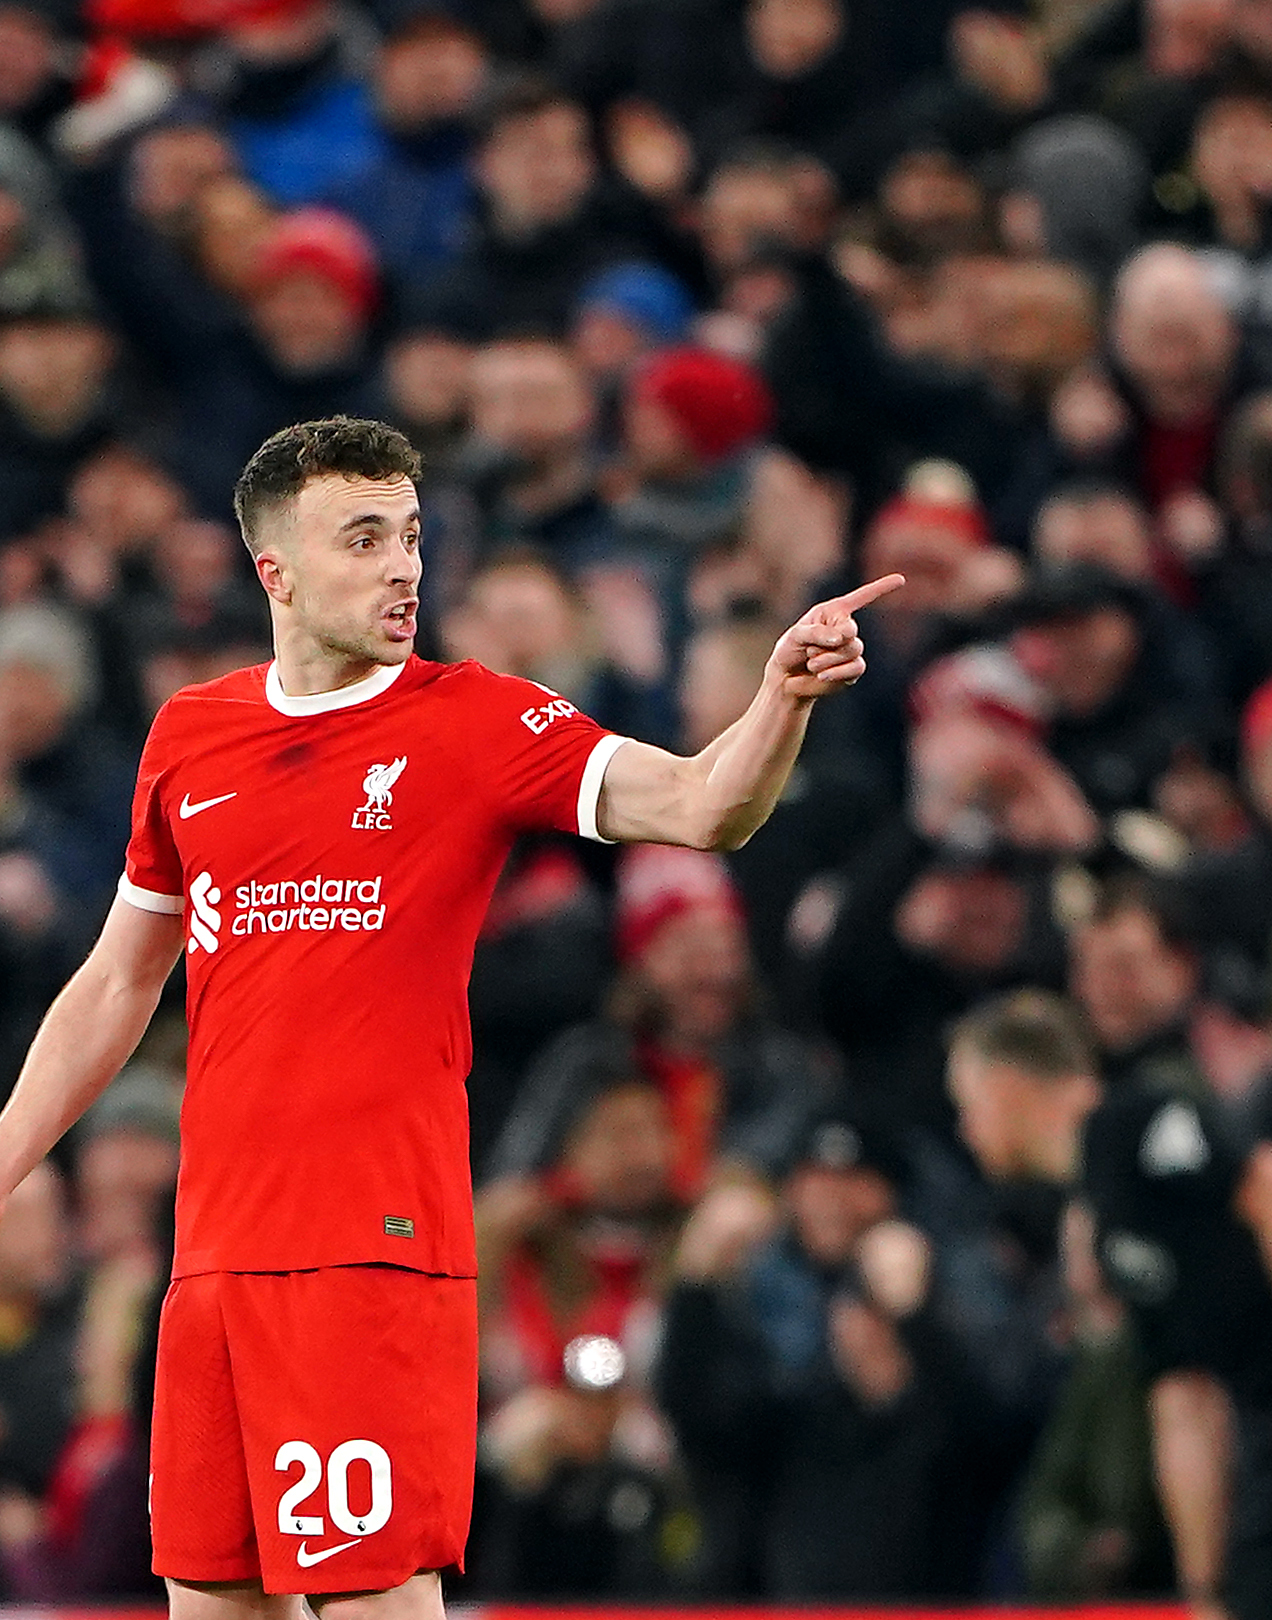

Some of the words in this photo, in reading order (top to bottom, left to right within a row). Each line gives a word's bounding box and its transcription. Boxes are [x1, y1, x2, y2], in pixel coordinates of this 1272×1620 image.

[520, 699, 579, 734] Exp
[351, 812, 393, 830] L.F.C.
[236, 875, 382, 909] standard
[232, 903, 386, 935] chartered
[274, 1439, 393, 1536] 20
